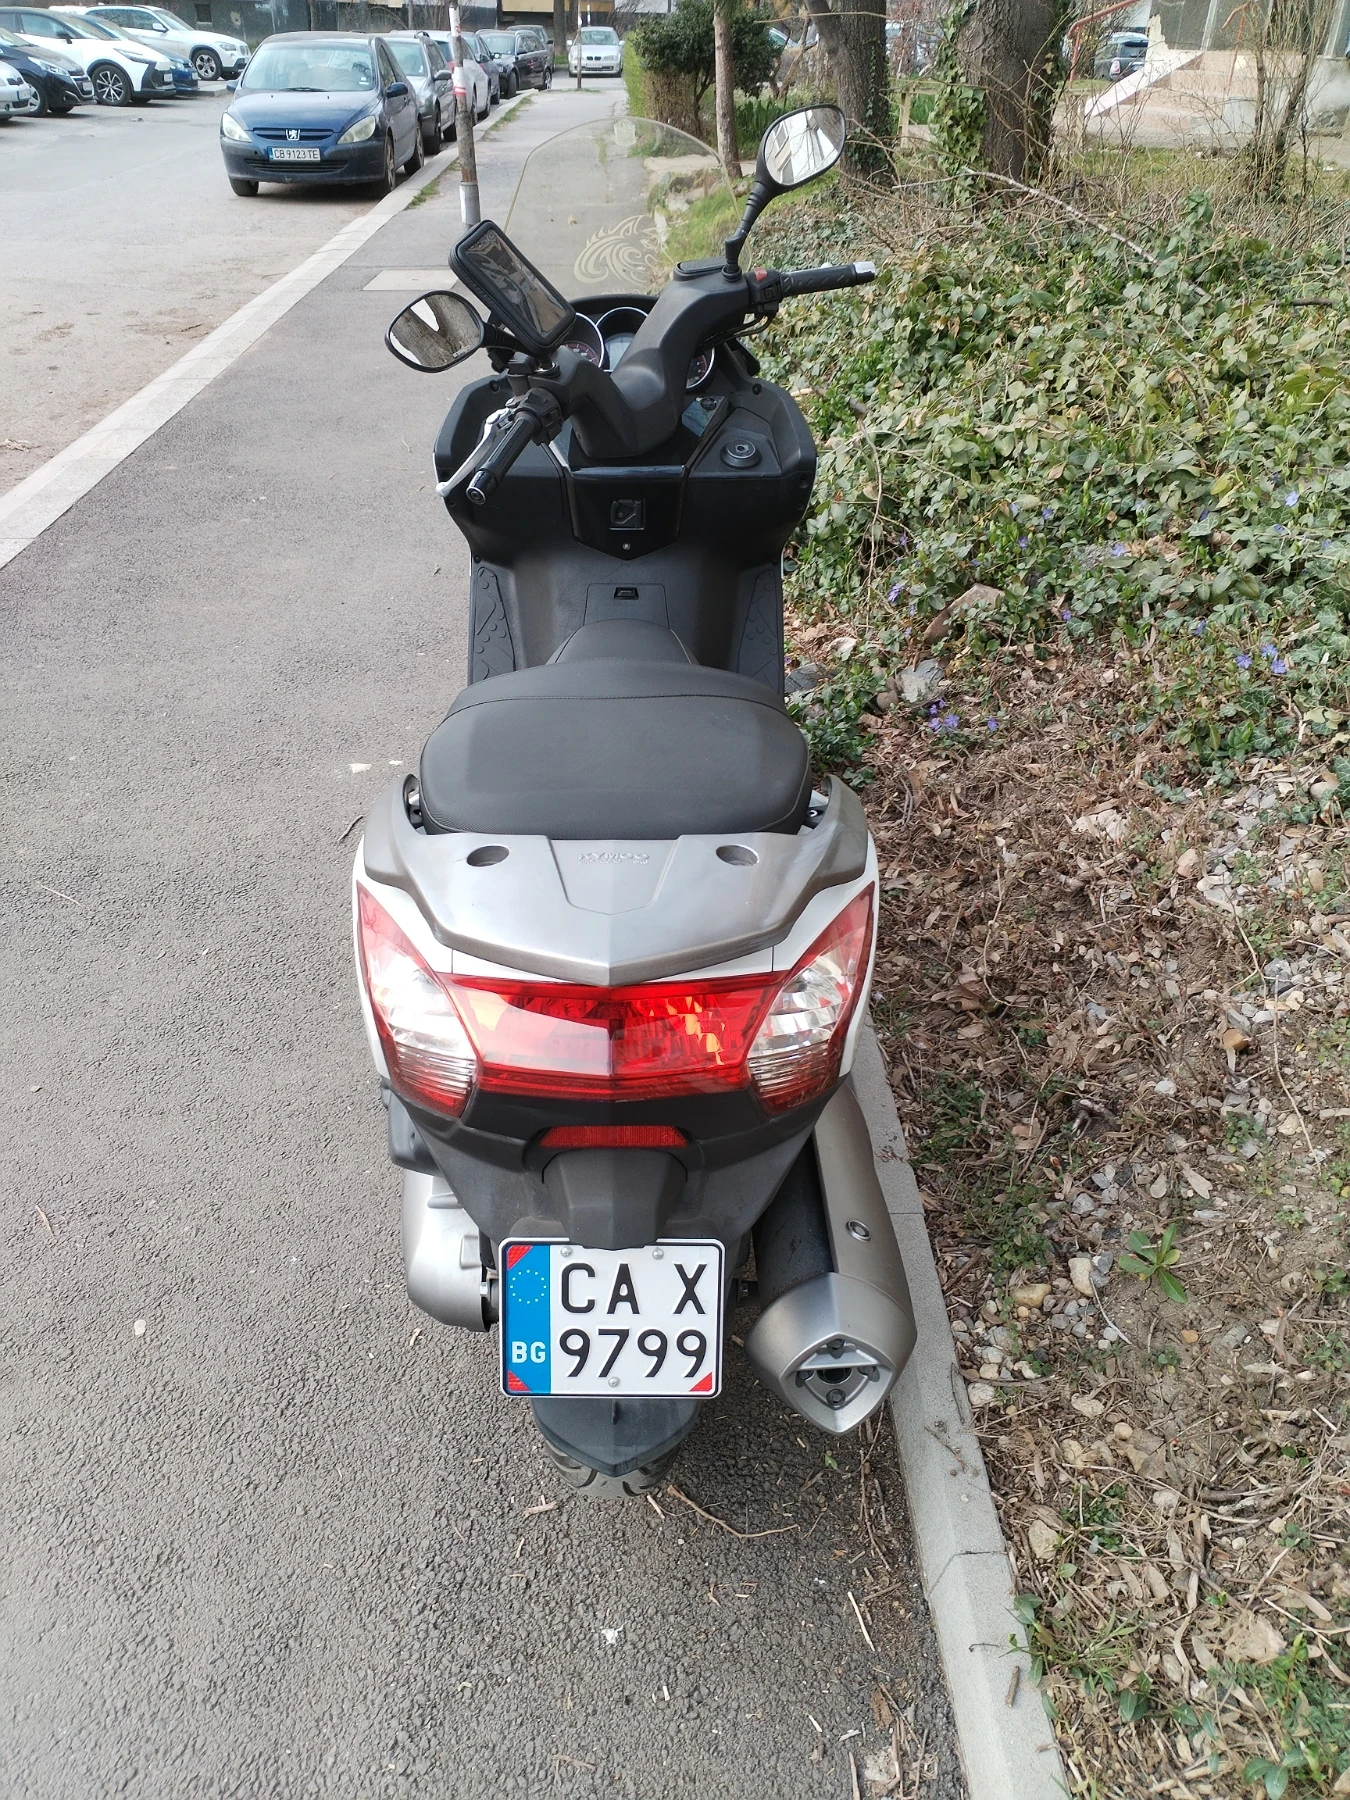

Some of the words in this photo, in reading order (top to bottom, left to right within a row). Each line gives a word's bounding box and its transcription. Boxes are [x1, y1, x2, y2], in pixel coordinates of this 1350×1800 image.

[286, 149, 306, 159] 9123
[307, 149, 319, 159] TE
[561, 1262, 641, 1315] CA
[673, 1263, 707, 1315] X
[511, 1340, 546, 1364] BG
[559, 1328, 707, 1378] 9799
